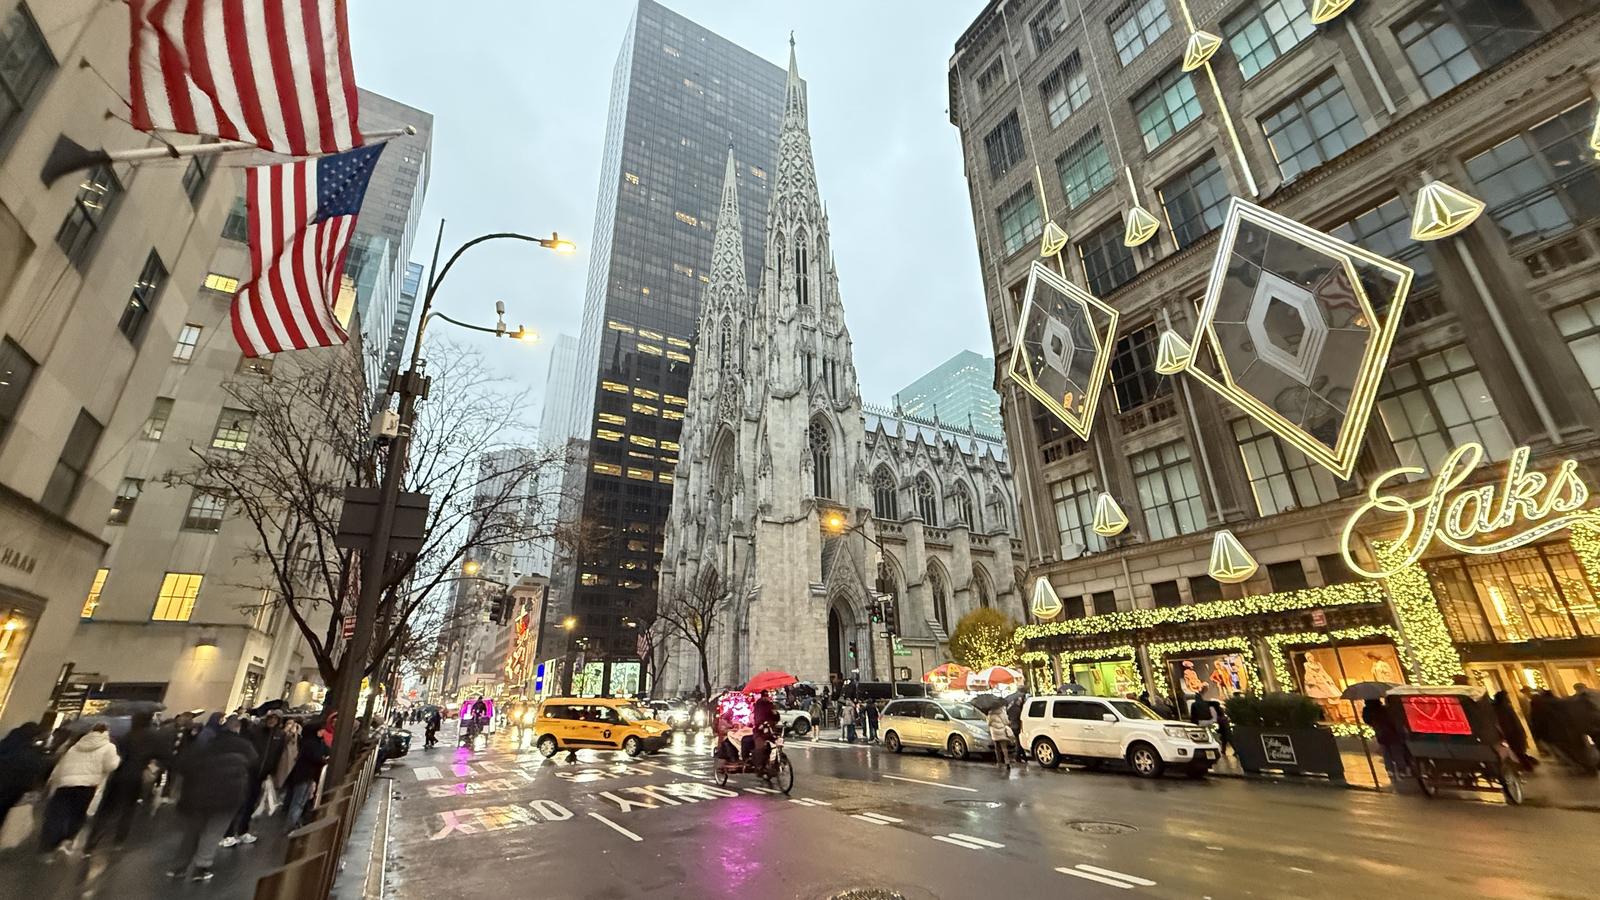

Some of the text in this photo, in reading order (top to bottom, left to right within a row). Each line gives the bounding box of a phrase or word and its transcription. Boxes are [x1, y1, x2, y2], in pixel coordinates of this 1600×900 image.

[1341, 442, 1590, 578] Saks
[1, 547, 38, 575] HAAN
[599, 782, 739, 813] ONLY
